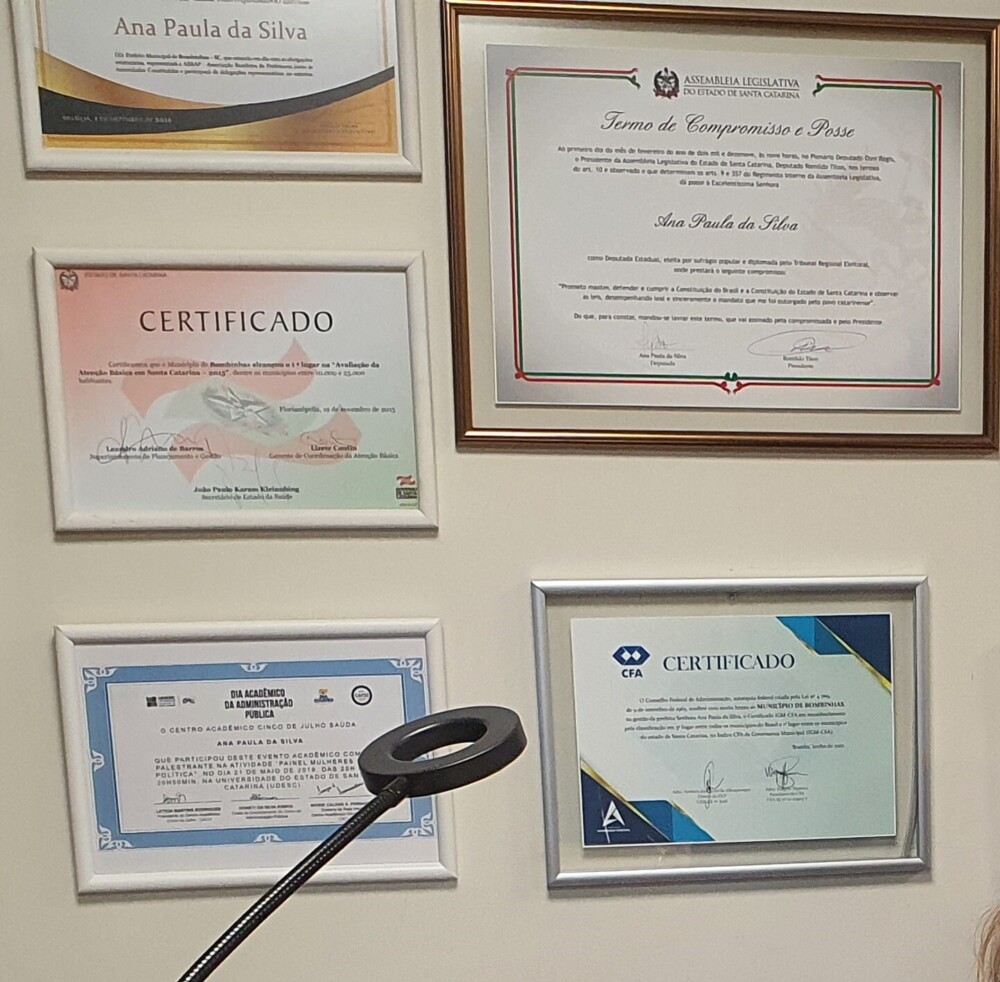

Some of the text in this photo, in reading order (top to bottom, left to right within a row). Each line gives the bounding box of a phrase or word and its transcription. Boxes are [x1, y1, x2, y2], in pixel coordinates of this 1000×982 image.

[115, 18, 306, 40] Ana Paula da Silva
[684, 74, 799, 88] ASSEMBLEIA LEGISLATIVA
[697, 88, 726, 96] ESTADO
[727, 89, 737, 97] DE
[739, 89, 762, 98] SANTA
[763, 90, 800, 99] CATARINA
[598, 111, 854, 138] Termo de Compromisso e Posse
[654, 212, 798, 230] Ana Paula da Silva
[140, 311, 333, 332] CERTIFICADO
[663, 654, 794, 670] CERTIFICADO
[621, 668, 642, 678] CFA
[230, 688, 286, 699] DIA ACADÊMICO
[224, 698, 293, 709] DA ADMINISTRAÇÃO
[245, 709, 274, 719] PÚBLICA
[206, 724, 254, 732] ACADÊMICO
[292, 751, 340, 759] ACADÊMICO
